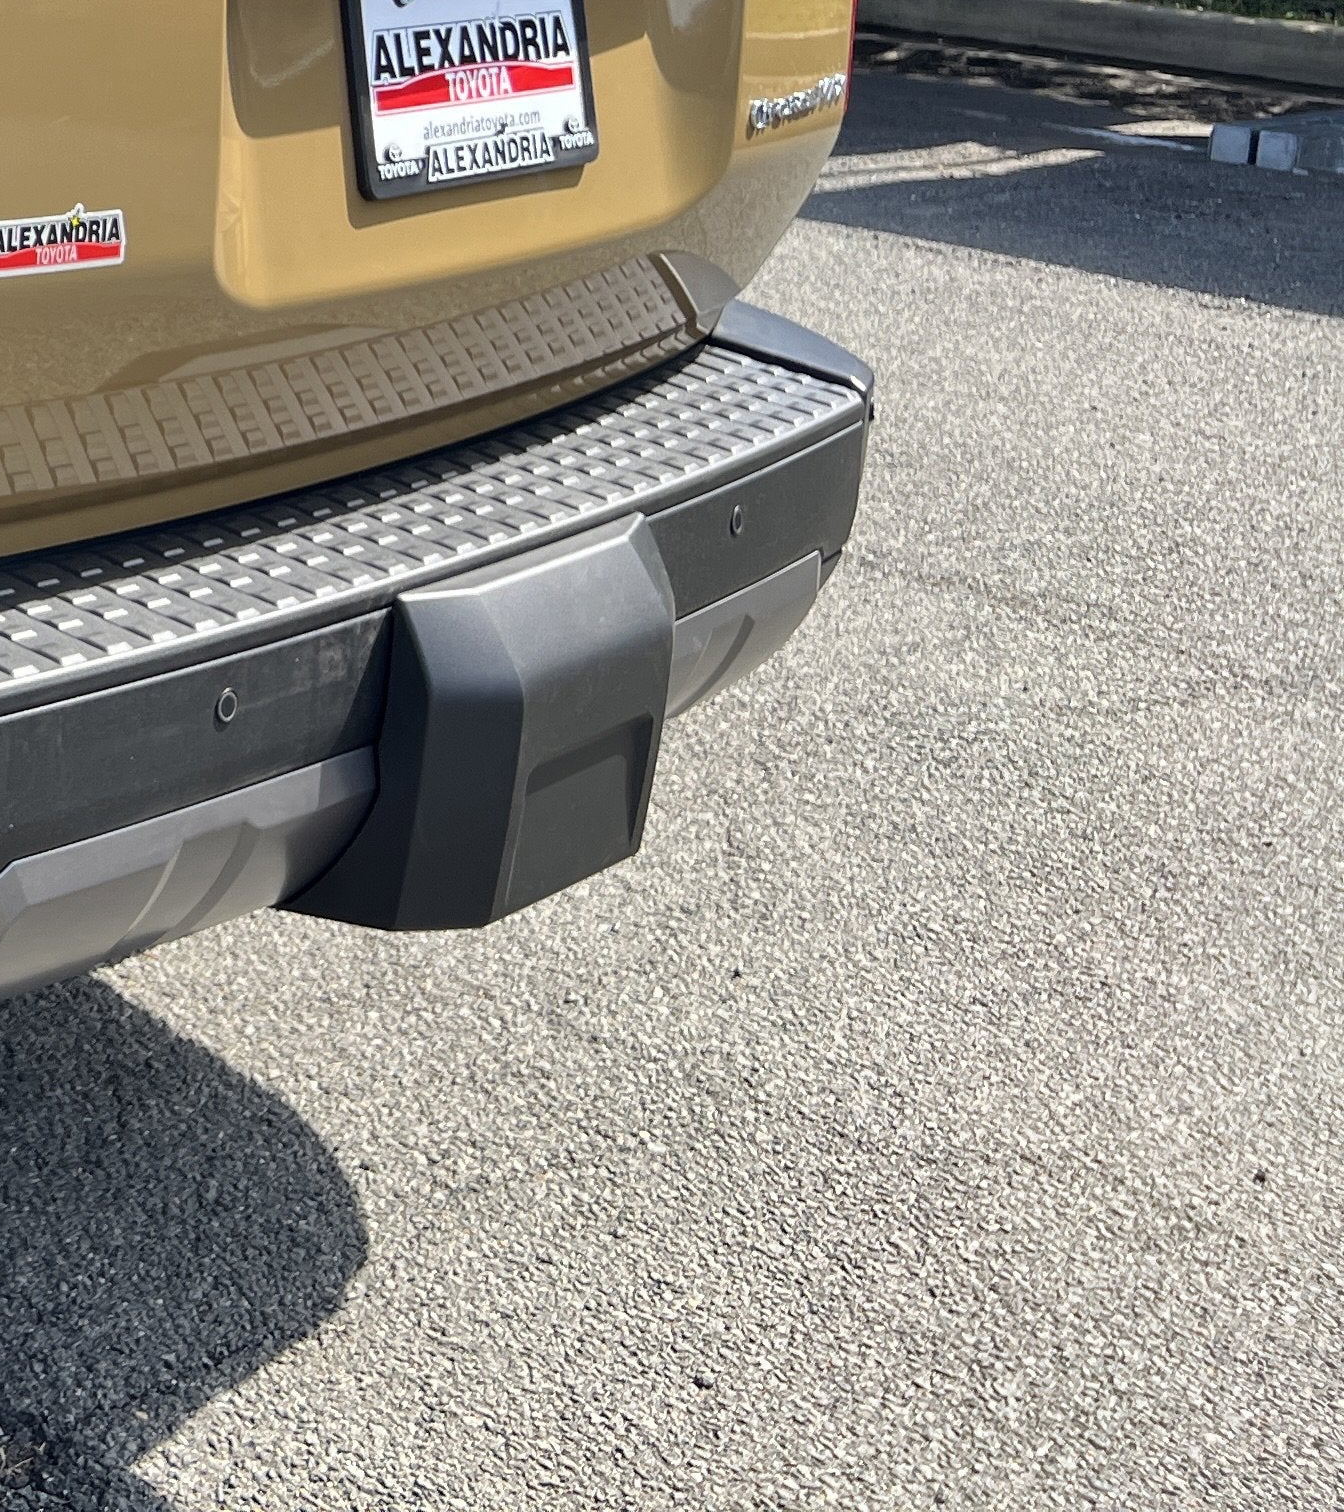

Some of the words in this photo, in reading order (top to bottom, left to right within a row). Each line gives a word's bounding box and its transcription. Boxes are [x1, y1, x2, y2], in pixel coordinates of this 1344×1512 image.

[373, 15, 569, 81] ALEXANDRIA
[445, 64, 513, 101] TOYOTA
[423, 108, 541, 140] alexandriatoyota.com
[430, 131, 553, 179] ALEXANDRIA
[559, 130, 595, 152] TOYOTA
[377, 160, 420, 181] TOYOTA
[35, 245, 78, 265] TOYOTA
